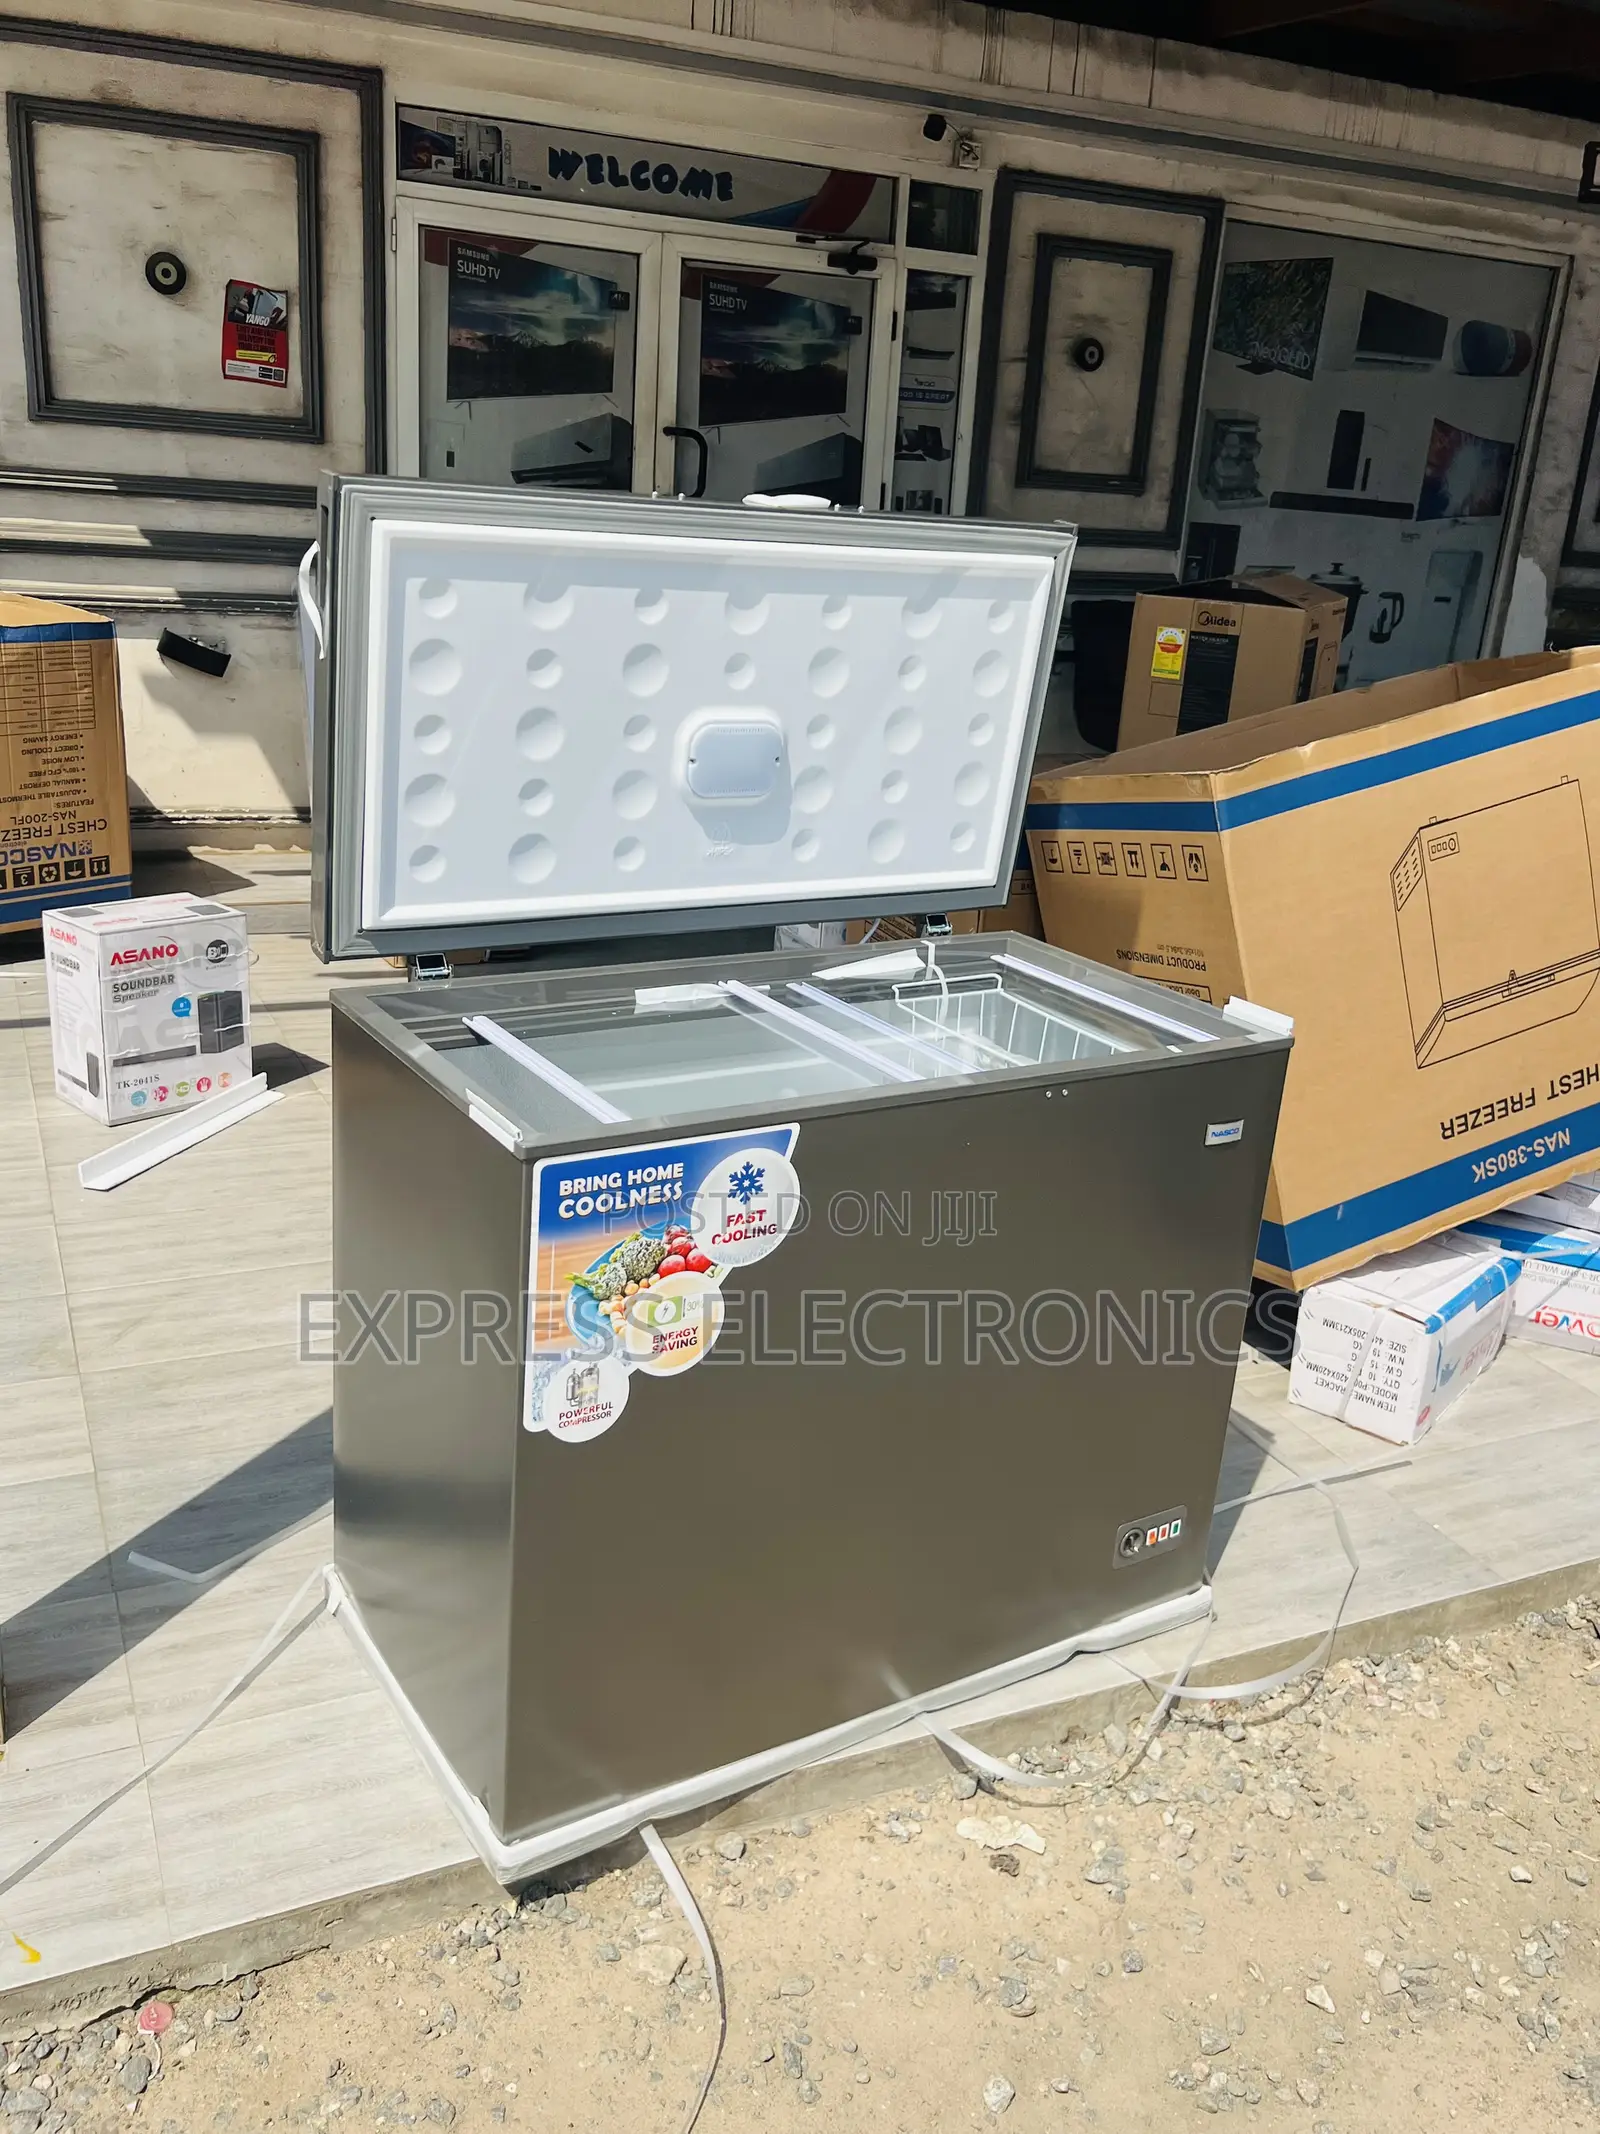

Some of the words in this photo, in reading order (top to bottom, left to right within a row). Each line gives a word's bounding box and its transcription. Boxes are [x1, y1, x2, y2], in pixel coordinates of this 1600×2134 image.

[548, 146, 734, 201] WELCOME
[457, 247, 490, 261] SAMSUNG
[245, 313, 270, 326] YANGO
[1198, 610, 1237, 628] Midea
[22, 735, 49, 744] SAVING
[50, 733, 78, 741] ENERGY
[21, 747, 53, 755] COOLING
[63, 755, 79, 763] LOW
[41, 757, 62, 765] NOISE
[28, 770, 47, 778] FREE
[53, 778, 81, 786] MANUAL
[19, 781, 51, 790] DEFROST
[37, 788, 82, 800] ADJUSTABLE
[53, 798, 95, 809] FEATURES:
[10, 809, 77, 826] NAS-200FL
[57, 818, 108, 836] CHEST
[49, 926, 78, 946] ASANO
[110, 943, 179, 966] ASANO
[1116, 949, 1164, 966] DIMENSIONS
[1166, 956, 1207, 972] PRODUCT
[112, 973, 176, 994] SOUNDBAR
[112, 988, 160, 1005] Speaker
[116, 1073, 160, 1090] TK-2041S
[1440, 1087, 1536, 1140] FREEZER
[1211, 1127, 1240, 1138] NASCO
[1471, 1127, 1571, 1184] NAS-380SK
[558, 1172, 623, 1198] BRING
[627, 1161, 684, 1186] HOME
[557, 1180, 684, 1220] COOLNESS
[725, 1209, 767, 1228] FAST
[711, 1223, 778, 1246] COOLING
[652, 1325, 699, 1344] ENERGY
[652, 1336, 698, 1354] SAVING
[558, 1401, 614, 1420] POWERFUL
[1376, 1400, 1397, 1413] ITEM
[558, 1410, 612, 1428] COMPRESSOR
